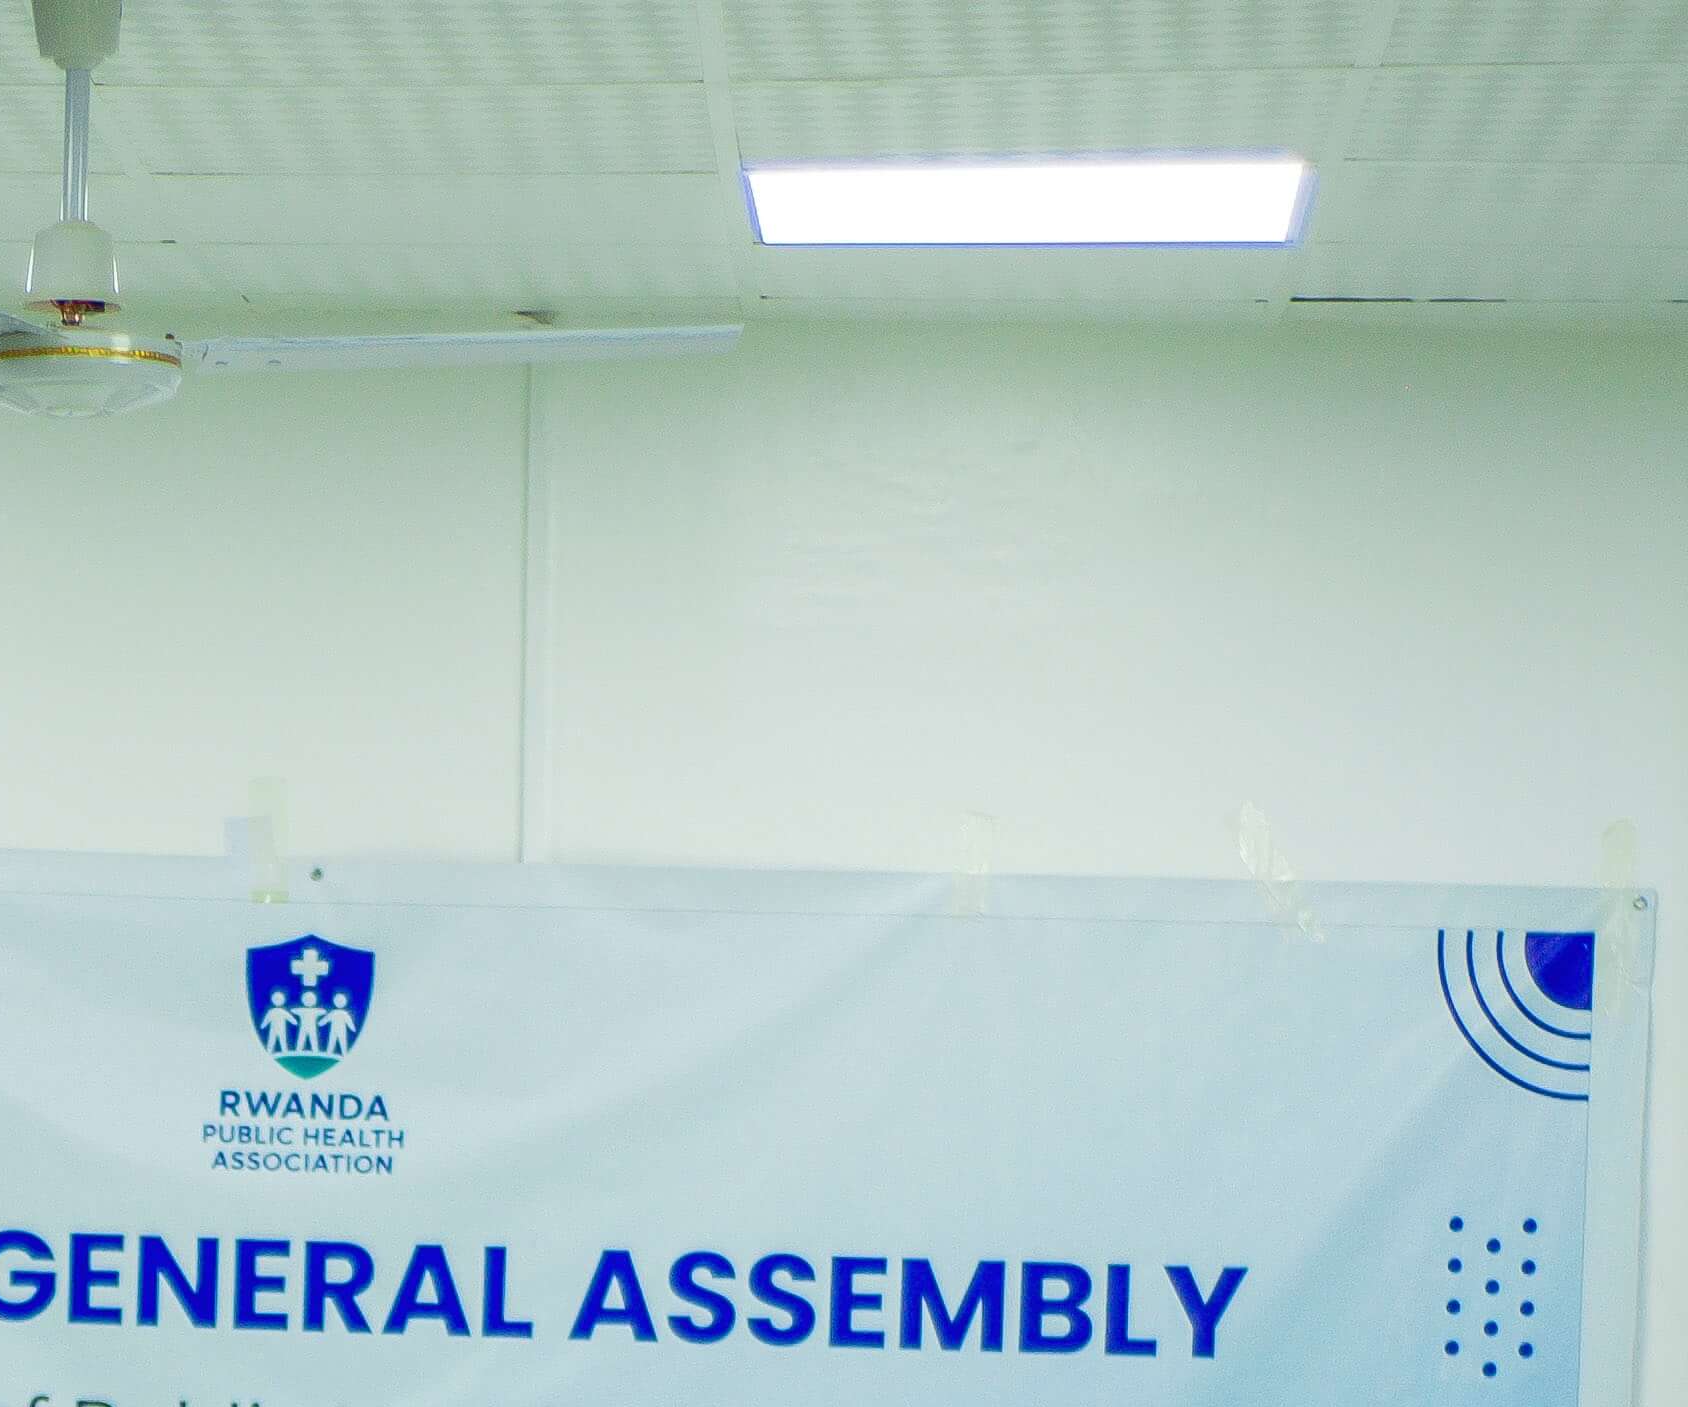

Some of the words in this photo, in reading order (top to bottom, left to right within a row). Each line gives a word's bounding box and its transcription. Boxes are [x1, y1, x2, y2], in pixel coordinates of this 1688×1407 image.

[219, 1090, 389, 1121] RWANDA
[203, 1124, 293, 1145] PUBLIC
[303, 1127, 405, 1148] HEALTH
[213, 1151, 393, 1174] ASSOCIATION
[569, 1249, 1249, 1360] ASSEMBLY
